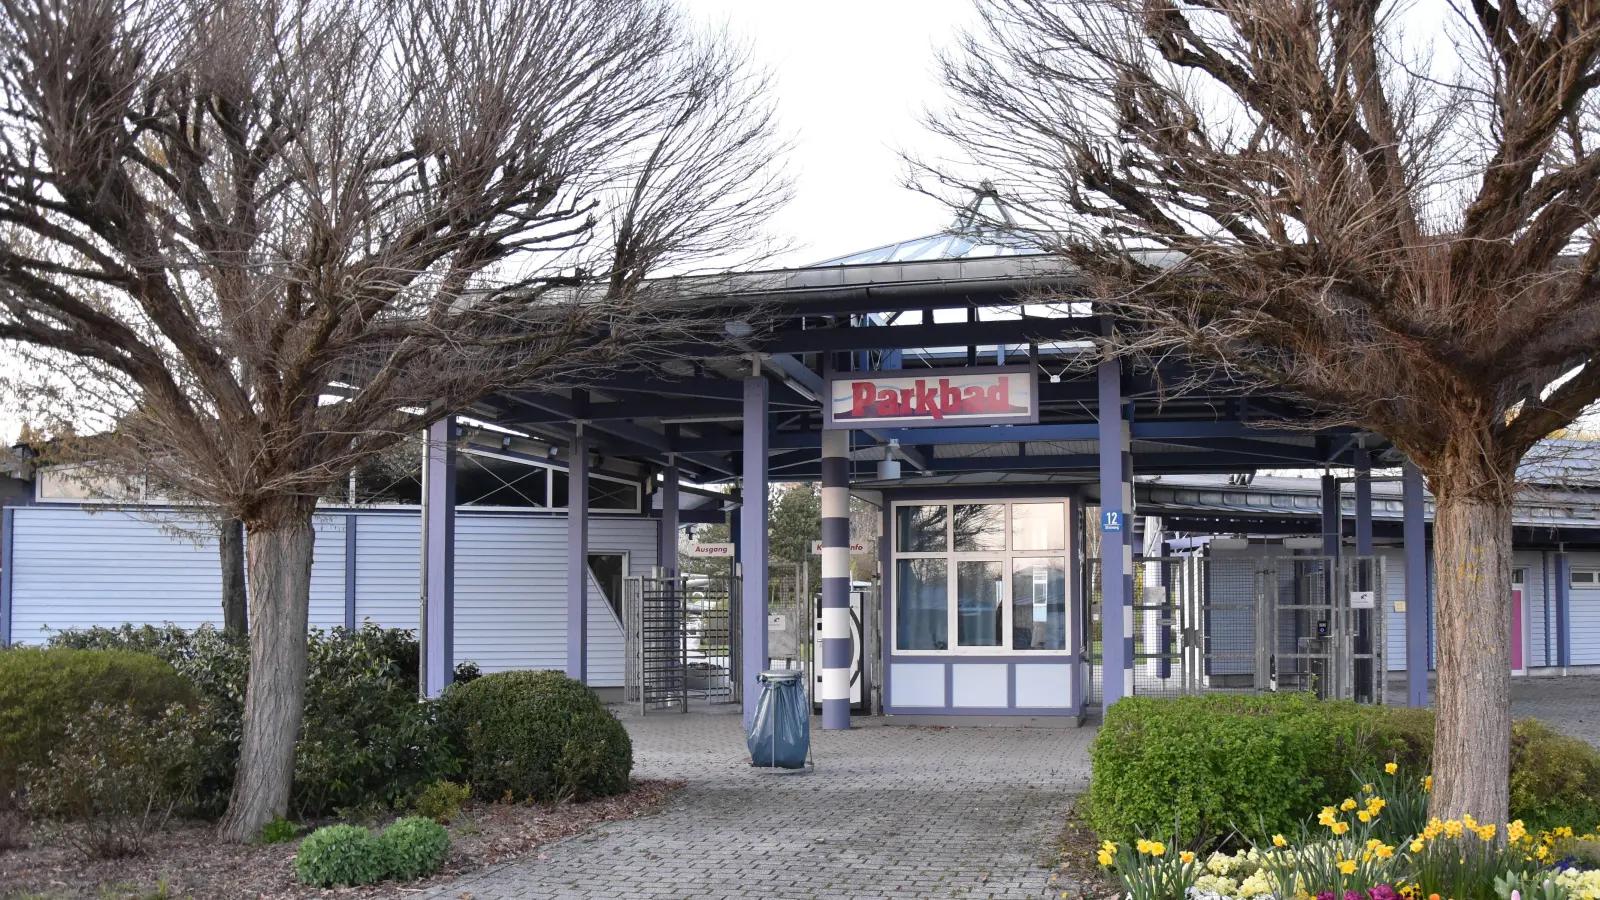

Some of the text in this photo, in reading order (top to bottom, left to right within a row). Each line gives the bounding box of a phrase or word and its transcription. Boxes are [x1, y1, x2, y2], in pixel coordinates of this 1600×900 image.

[851, 376, 1011, 420] Parkbad
[1106, 511, 1118, 525] 12
[694, 545, 728, 554] Ausgang
[848, 543, 863, 551] nfo
